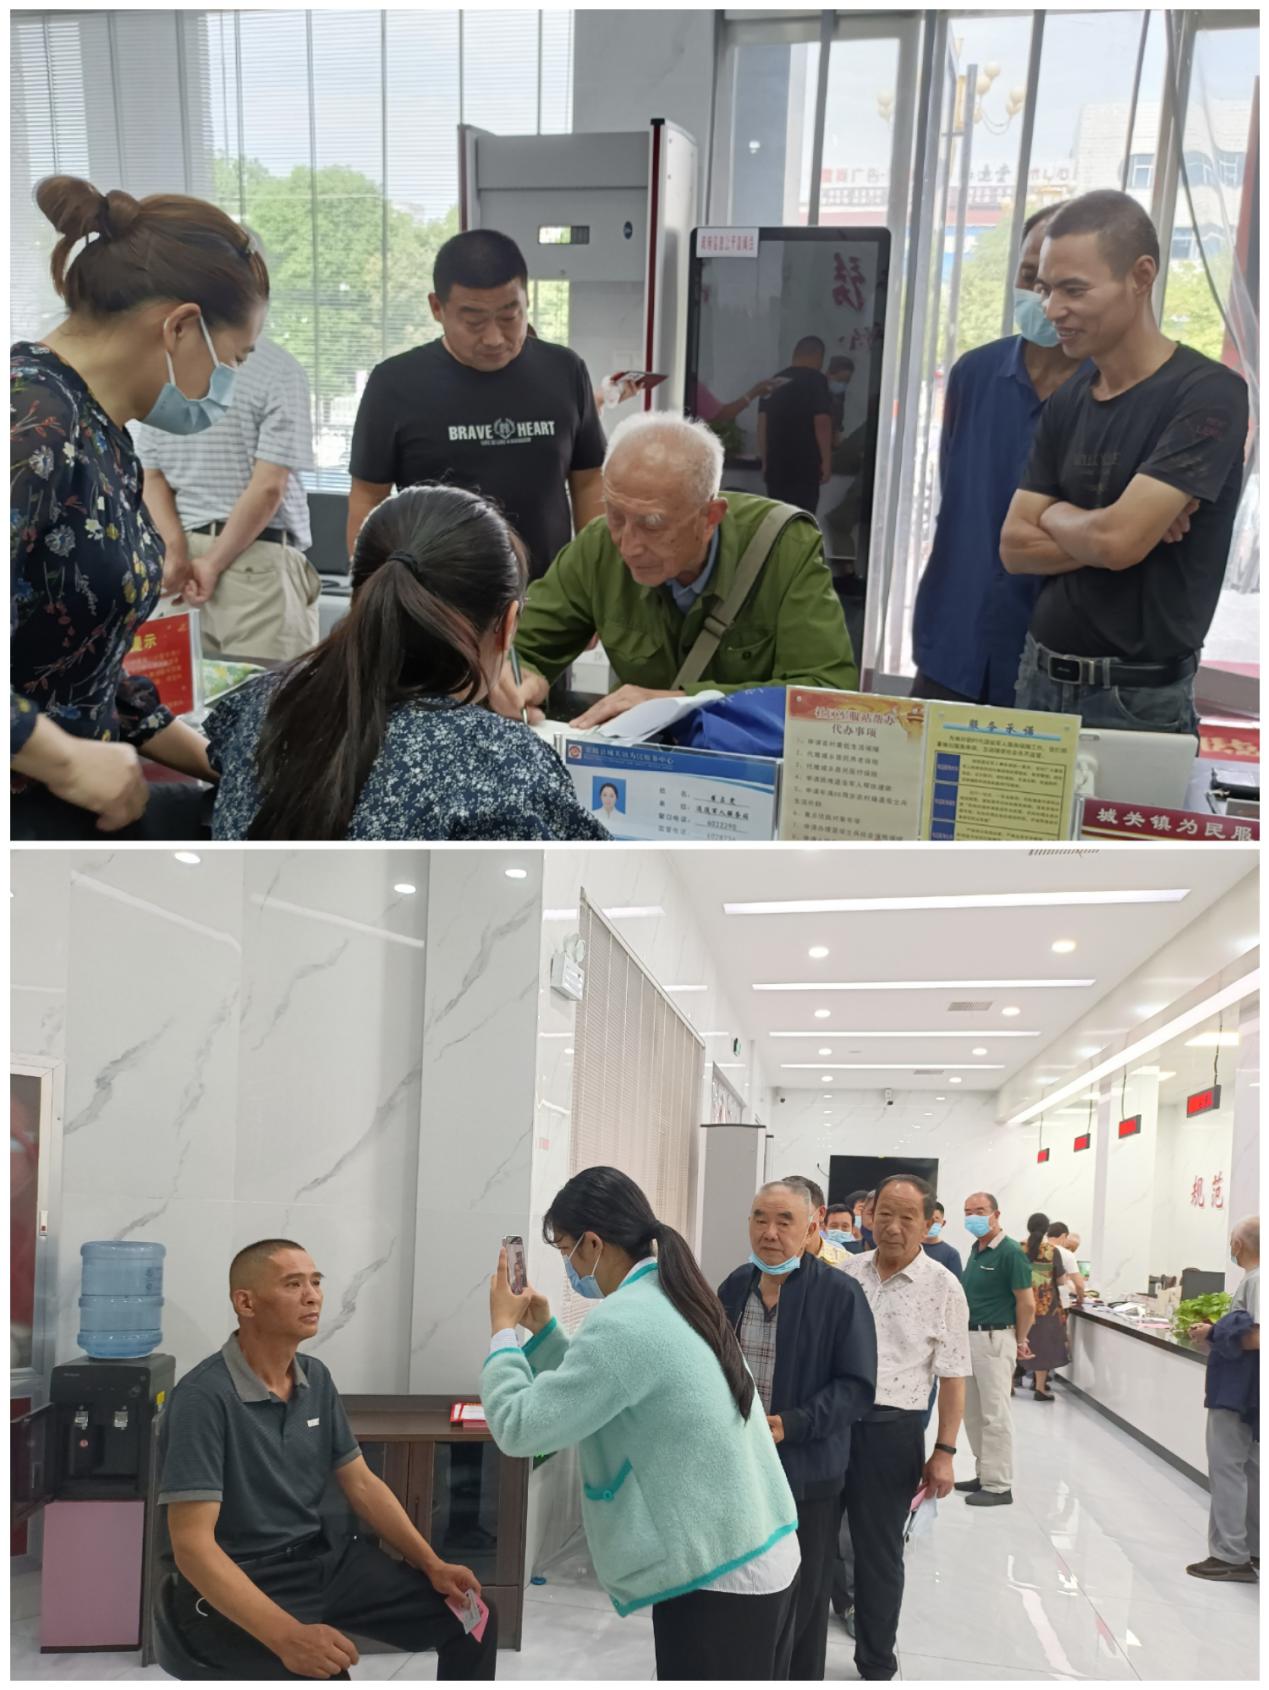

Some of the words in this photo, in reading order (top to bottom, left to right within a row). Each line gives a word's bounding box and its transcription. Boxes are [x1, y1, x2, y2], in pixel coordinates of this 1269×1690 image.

[448, 424, 494, 441] BRAVE
[517, 420, 555, 437] HEART
[832, 722, 877, 738] 代办事项
[968, 718, 1035, 737] 服务承诺
[1096, 807, 1253, 840] 城关镇为民服
[1190, 1170, 1224, 1209] 规范
